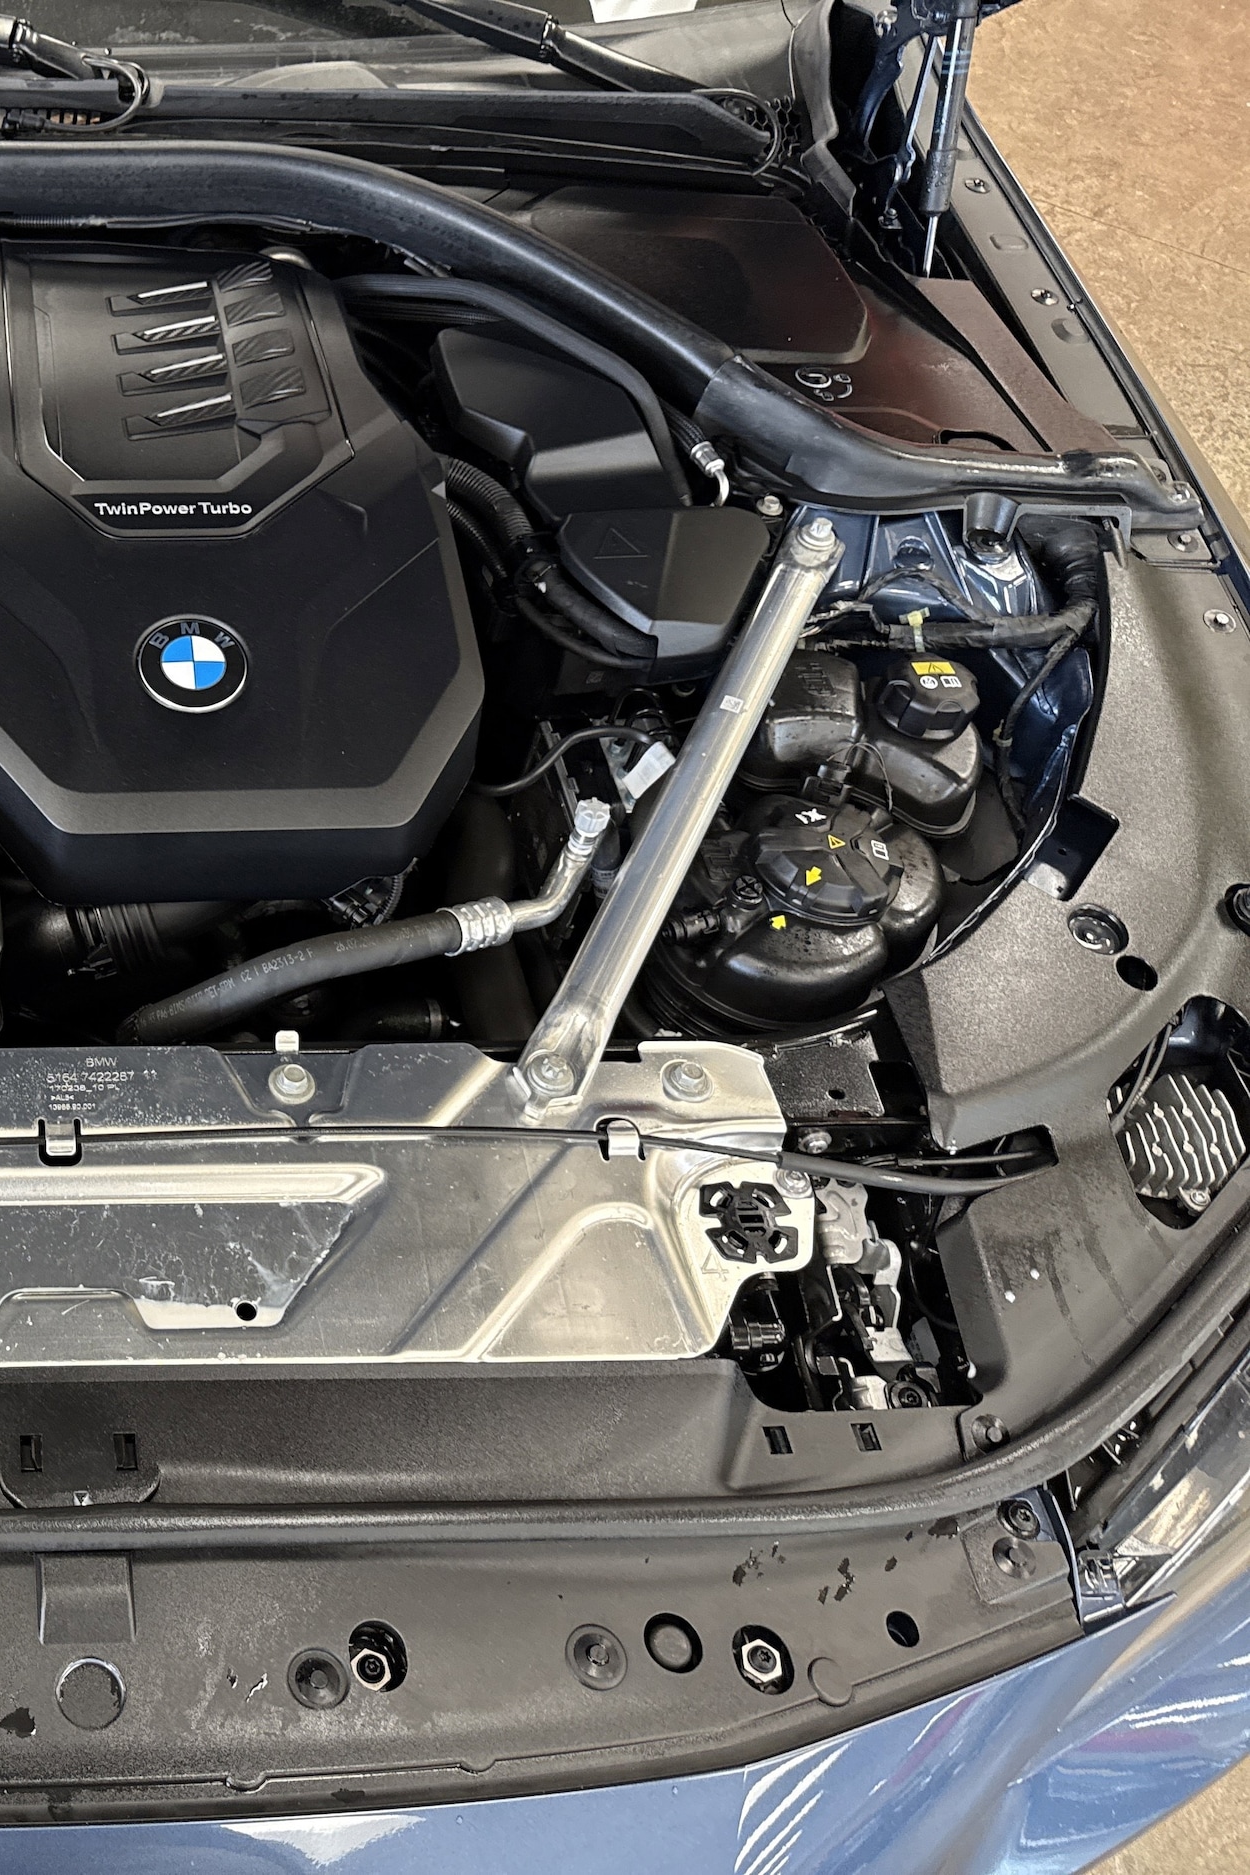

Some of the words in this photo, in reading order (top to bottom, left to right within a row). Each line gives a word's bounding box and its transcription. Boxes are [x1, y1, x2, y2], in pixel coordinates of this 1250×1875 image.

[93, 502, 196, 516] TwinPower
[198, 501, 253, 515] Turbo
[148, 621, 236, 650] BMW
[85, 1057, 118, 1068] BMW
[46, 1072, 78, 1084] 5164
